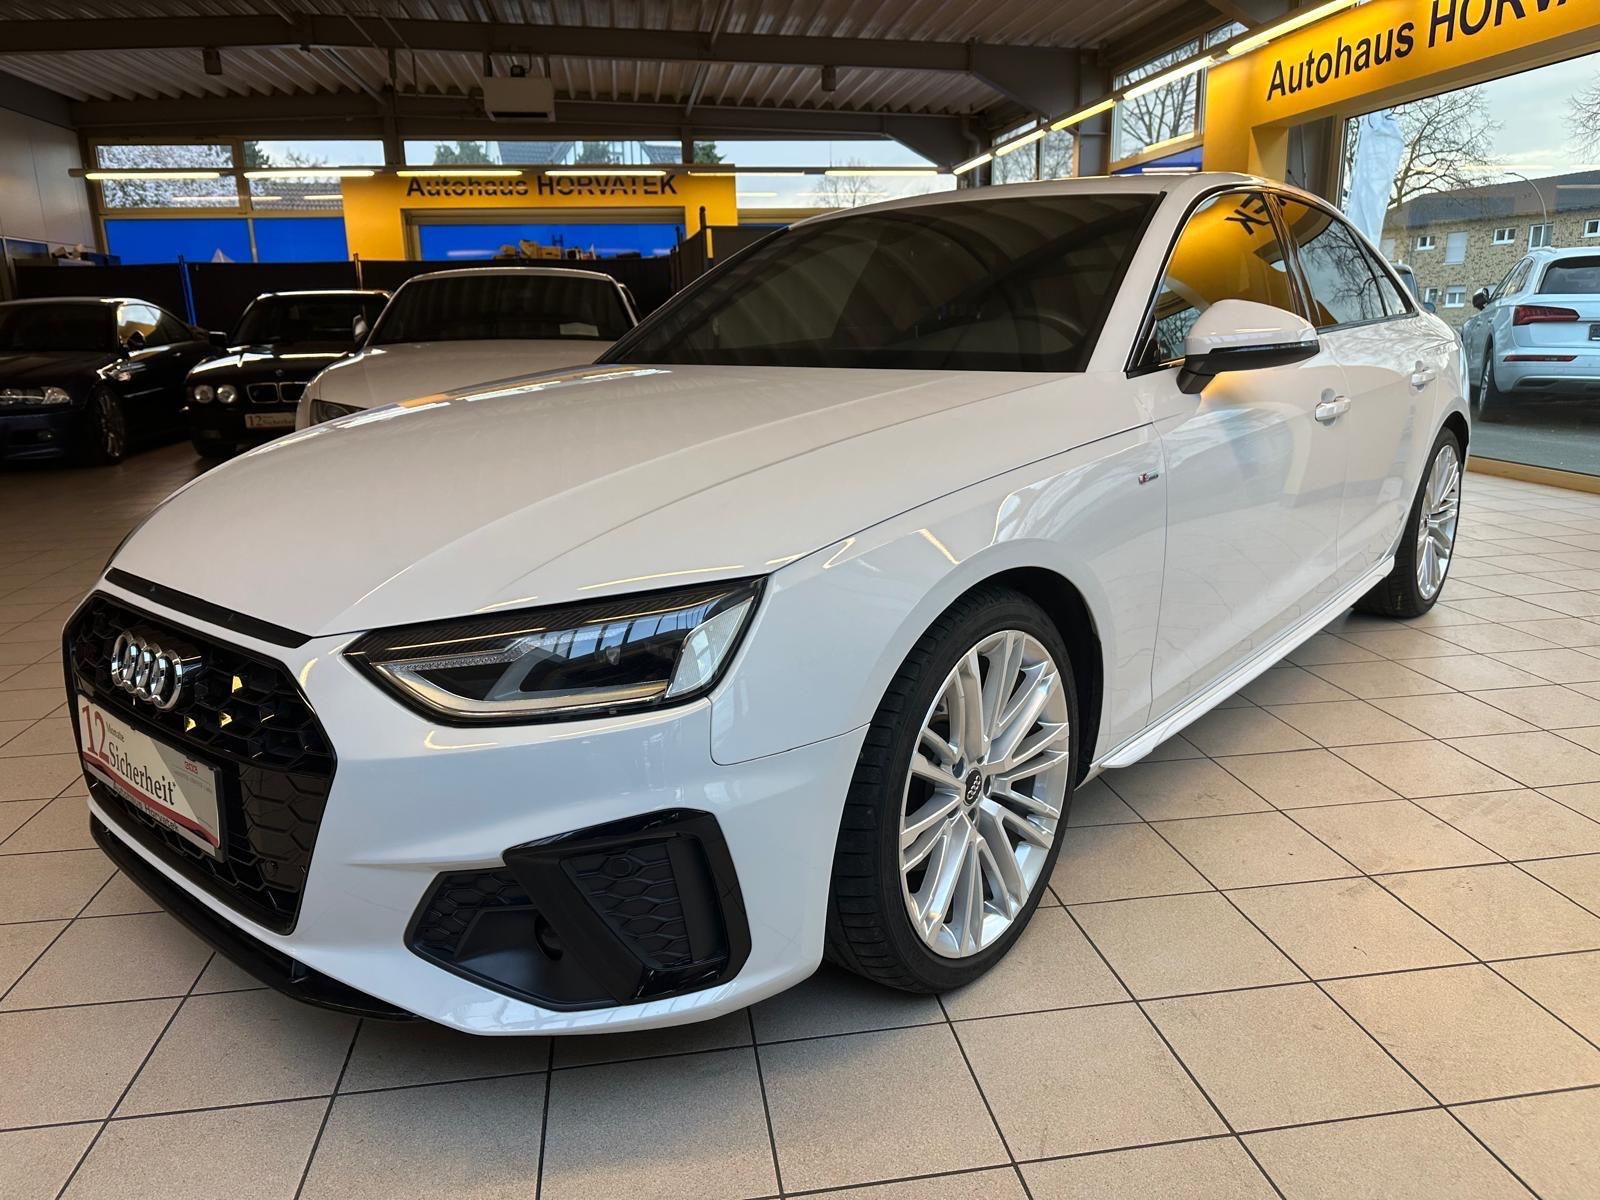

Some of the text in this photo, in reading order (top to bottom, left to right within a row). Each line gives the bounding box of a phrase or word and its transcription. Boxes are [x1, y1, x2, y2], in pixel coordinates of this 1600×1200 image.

[1267, 21, 1414, 101] Autohaus
[407, 175, 677, 197] Autohaus HORVATEK
[82, 705, 110, 765] 12
